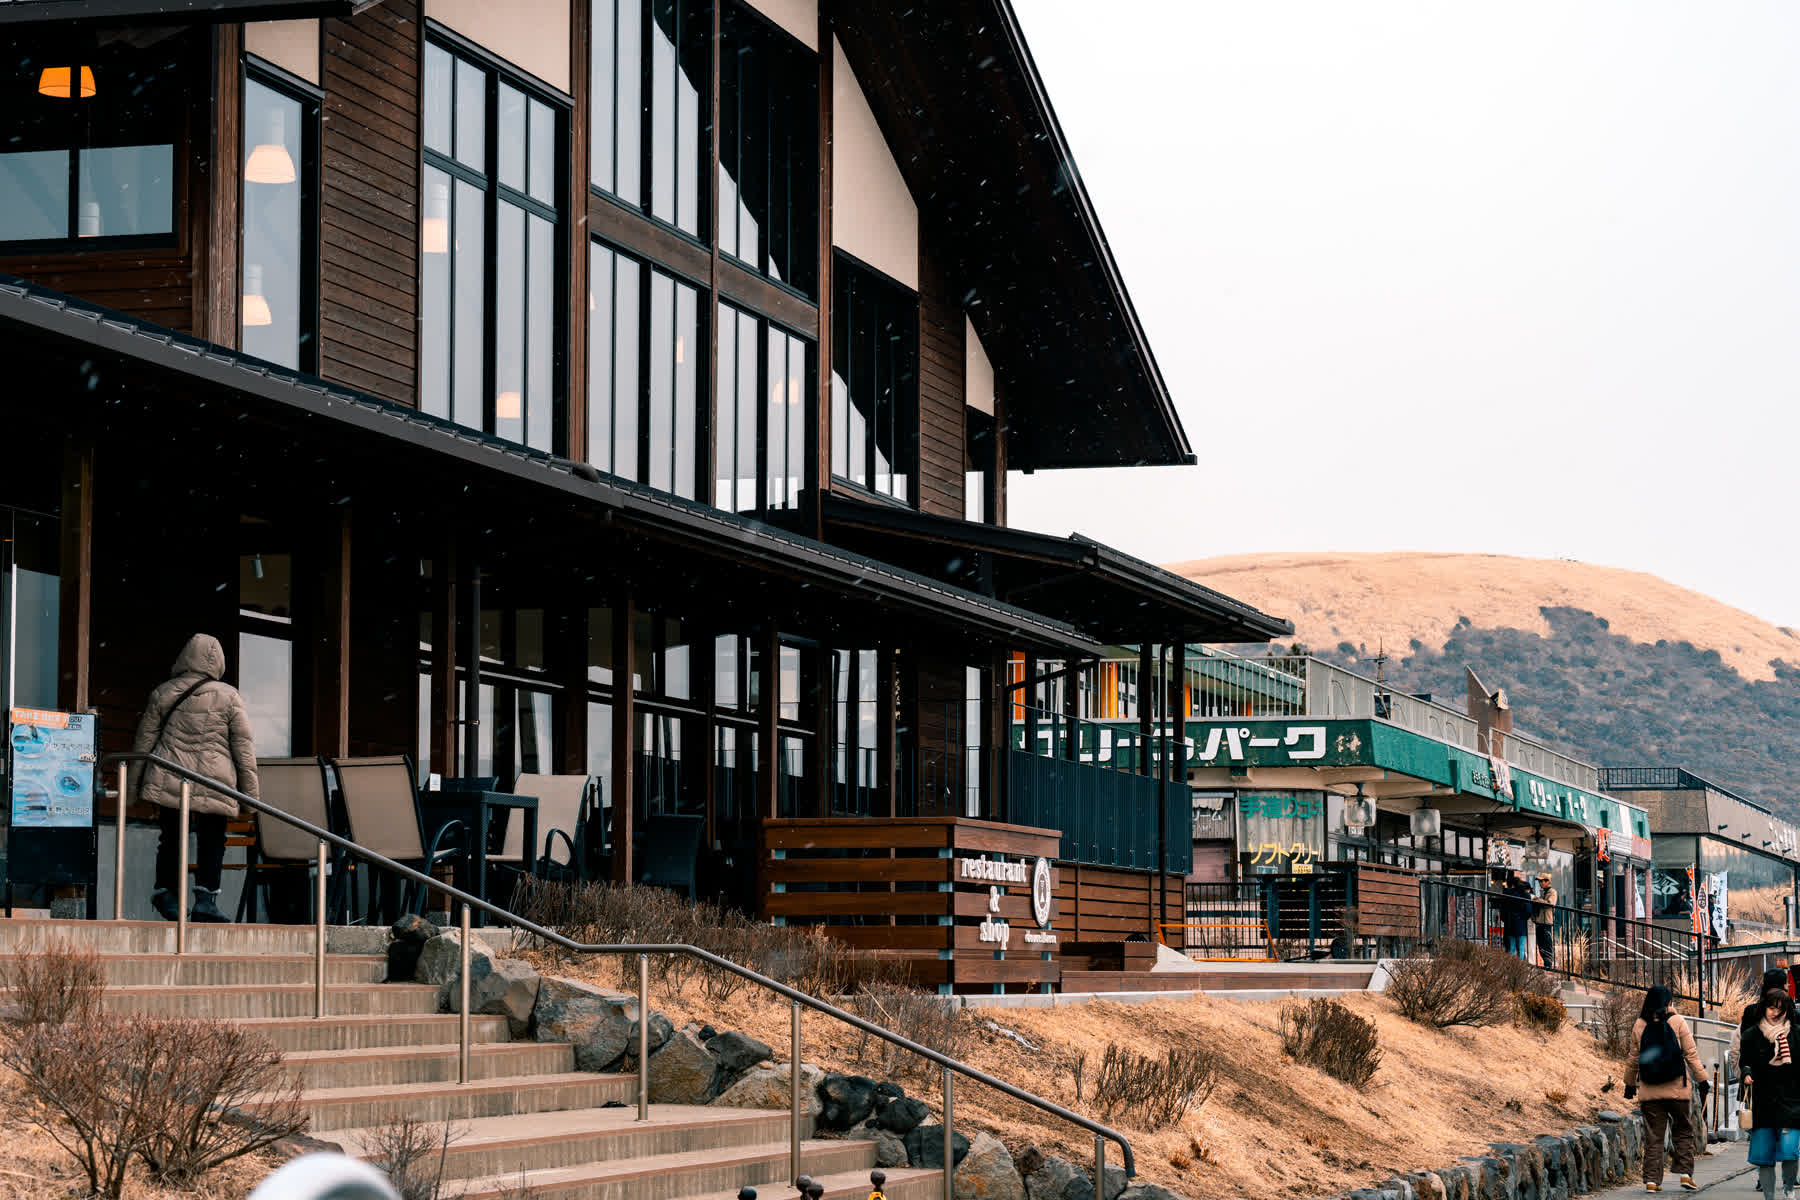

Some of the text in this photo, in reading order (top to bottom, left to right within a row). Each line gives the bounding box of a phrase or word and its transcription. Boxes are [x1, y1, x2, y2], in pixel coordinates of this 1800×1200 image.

[961, 854, 1027, 882] restaurant
[989, 885, 1000, 912] &
[980, 913, 1010, 950] shop
